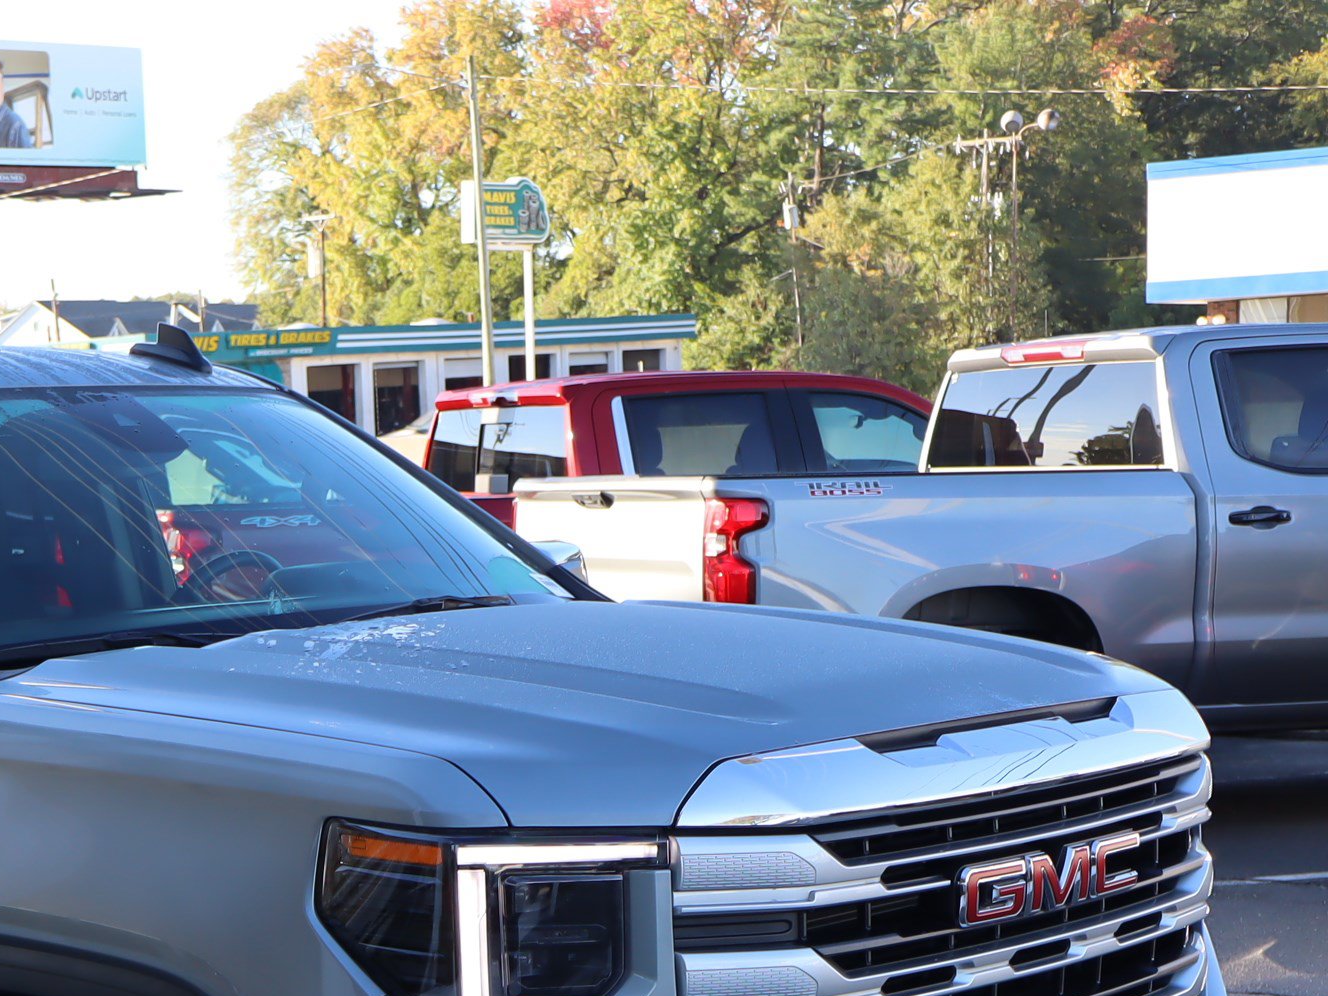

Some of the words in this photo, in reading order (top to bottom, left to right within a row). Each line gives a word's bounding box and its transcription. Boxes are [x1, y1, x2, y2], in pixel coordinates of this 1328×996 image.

[85, 87, 128, 103] Upstart
[483, 191, 516, 203] MAVIS
[486, 205, 509, 215] TIRES
[193, 336, 219, 352] VIS
[230, 334, 267, 346] TIRES
[280, 331, 331, 345] BRAKES
[240, 514, 321, 528] 4X4
[957, 832, 1141, 929] GMC
